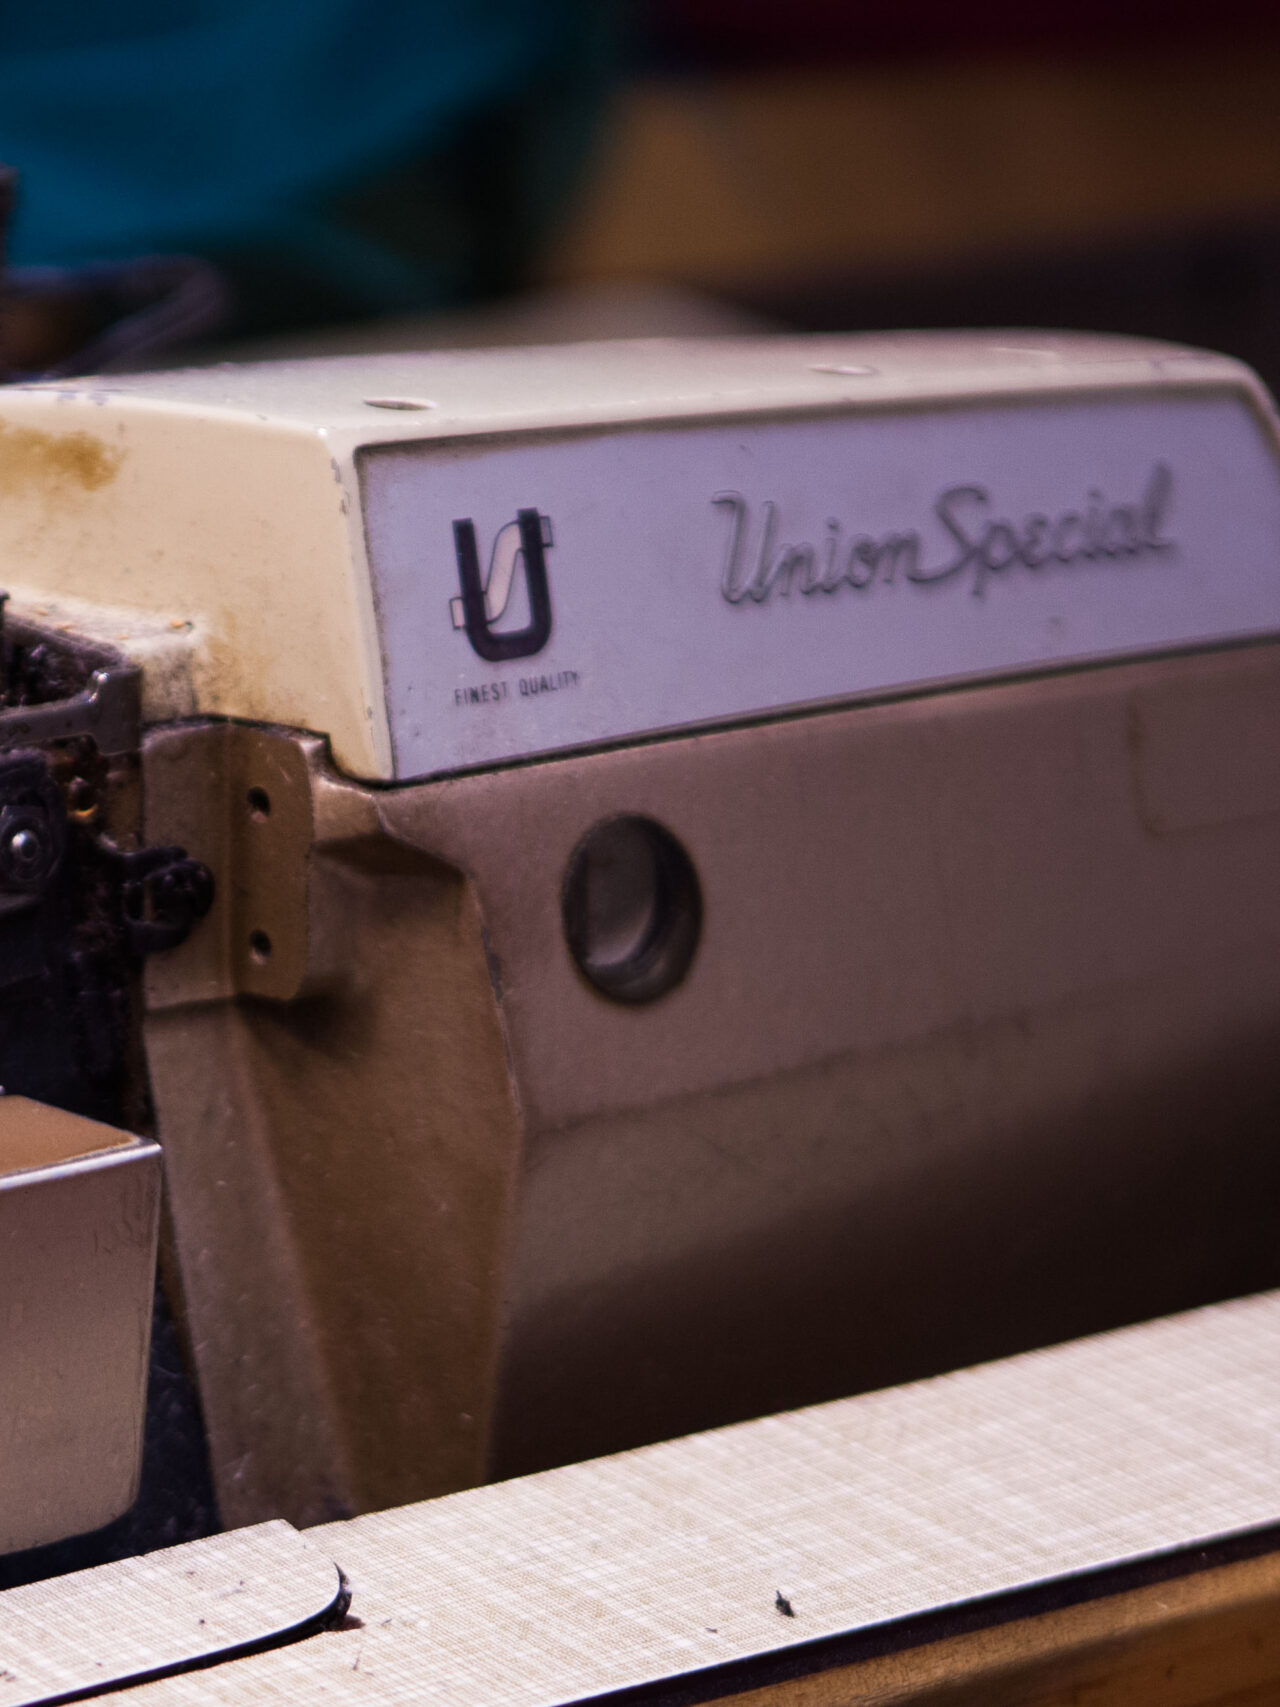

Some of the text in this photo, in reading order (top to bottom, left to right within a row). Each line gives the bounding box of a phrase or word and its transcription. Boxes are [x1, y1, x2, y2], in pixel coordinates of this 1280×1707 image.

[711, 461, 1178, 604] Union Special
[454, 670, 579, 705] FINEST QUALITY
